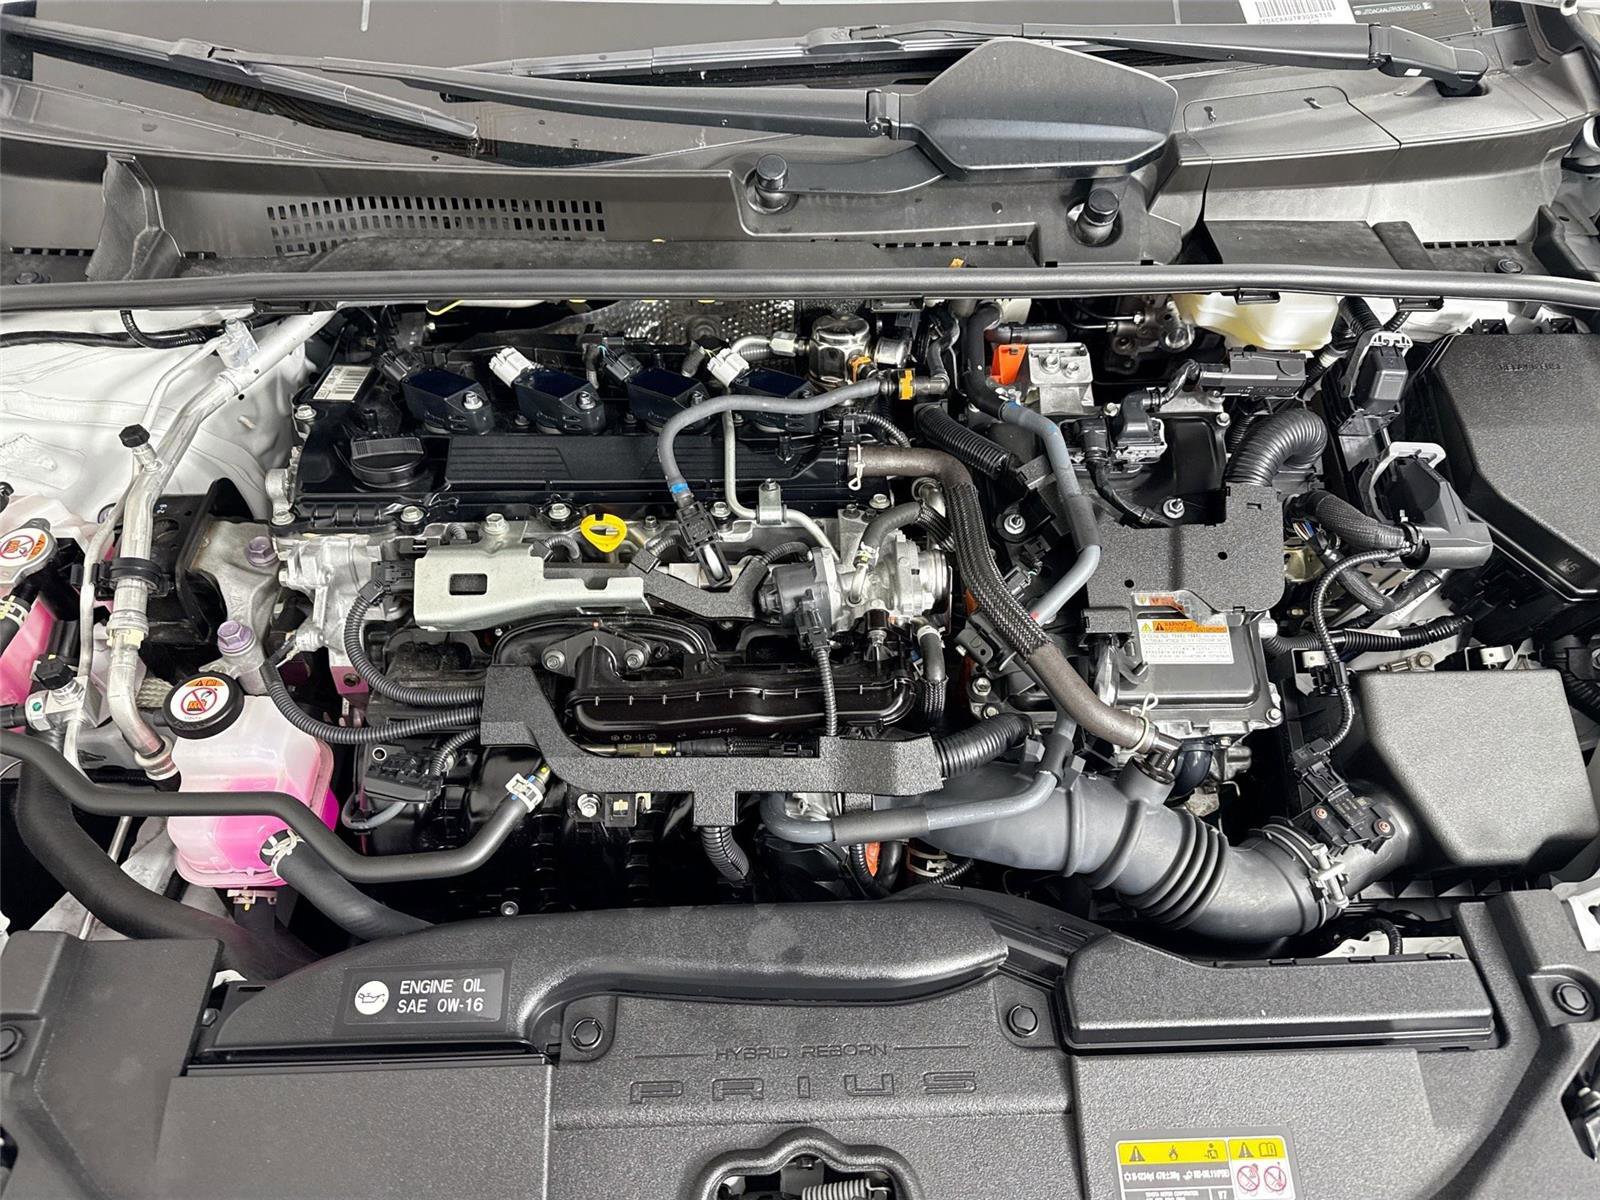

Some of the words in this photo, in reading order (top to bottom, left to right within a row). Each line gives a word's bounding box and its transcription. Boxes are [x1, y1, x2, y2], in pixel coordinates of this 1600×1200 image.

[400, 979, 454, 995] ENGINE
[463, 978, 486, 993] OIL
[397, 999, 427, 1014] SAE
[437, 997, 484, 1013] 0W-16
[714, 1046, 789, 1061] HYBRID
[800, 1043, 888, 1058] REBORN
[630, 1071, 977, 1104] PRIUS
